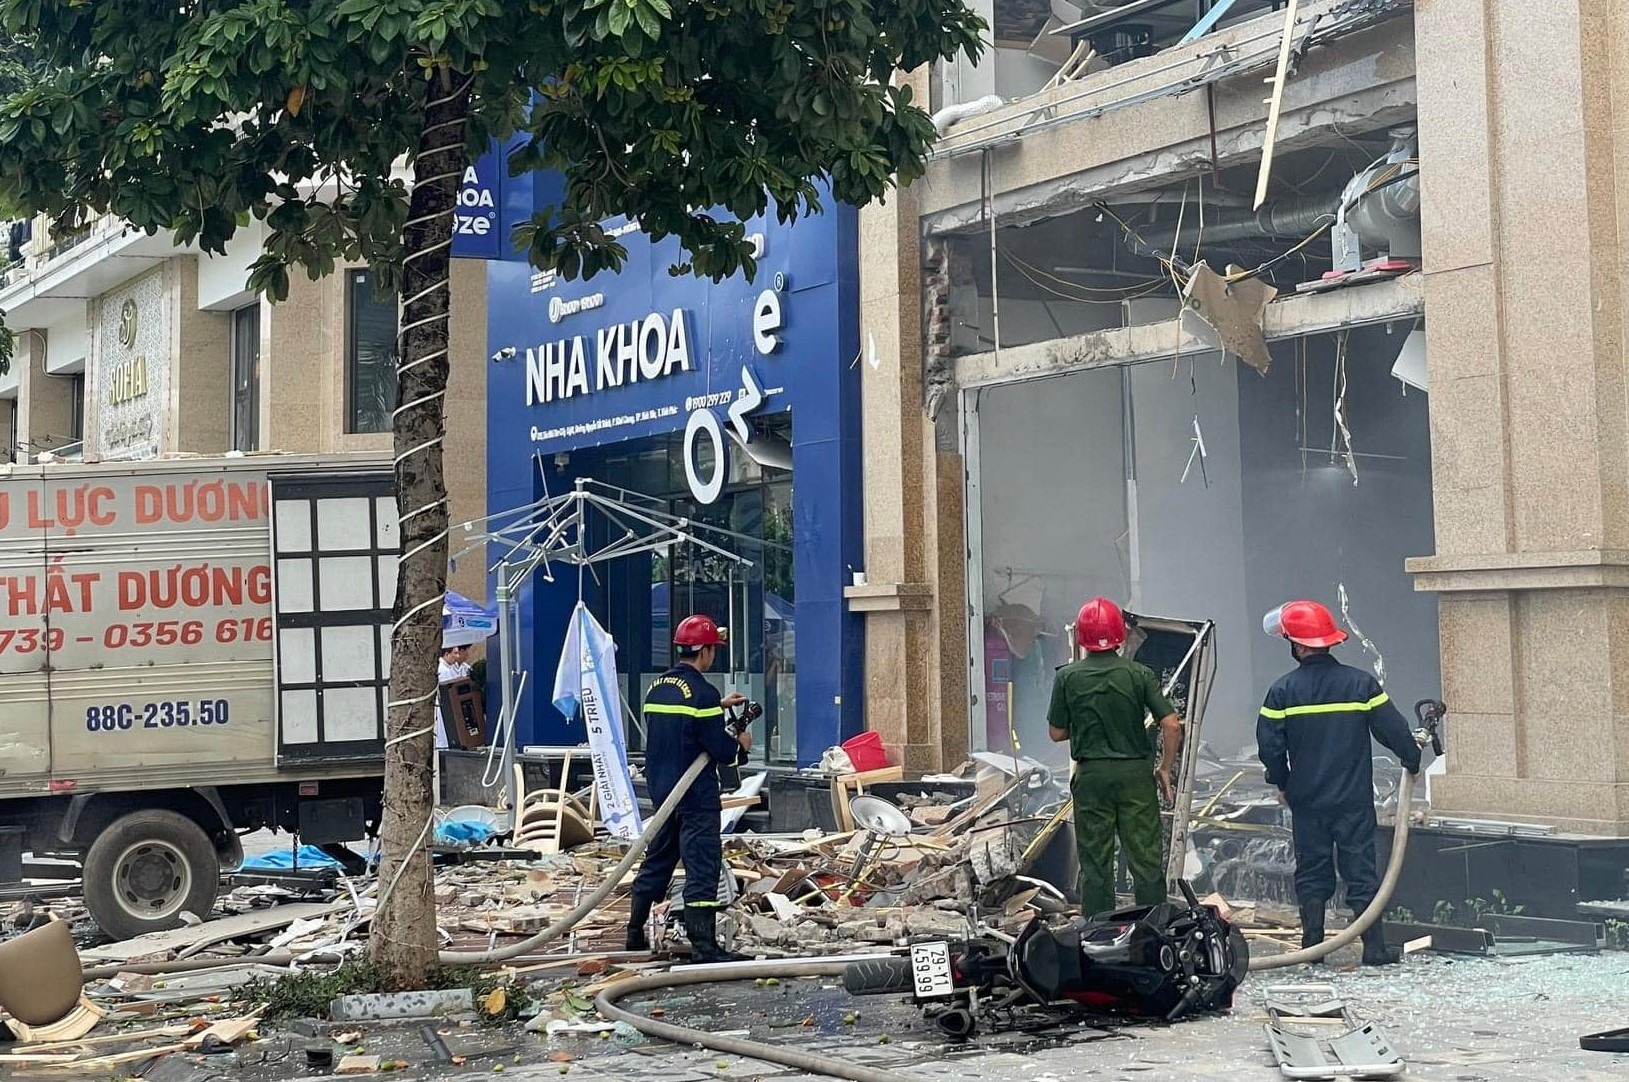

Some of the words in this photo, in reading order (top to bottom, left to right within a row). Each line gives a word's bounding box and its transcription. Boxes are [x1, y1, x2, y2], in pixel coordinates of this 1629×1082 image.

[526, 335, 589, 406] NHA
[596, 308, 690, 391] KHOA
[27, 482, 117, 536] LỰC
[103, 620, 204, 650] 0356
[86, 698, 230, 732] 88C-235.50
[914, 948, 933, 993] 459.99
[931, 950, 949, 986] 29-Y1
